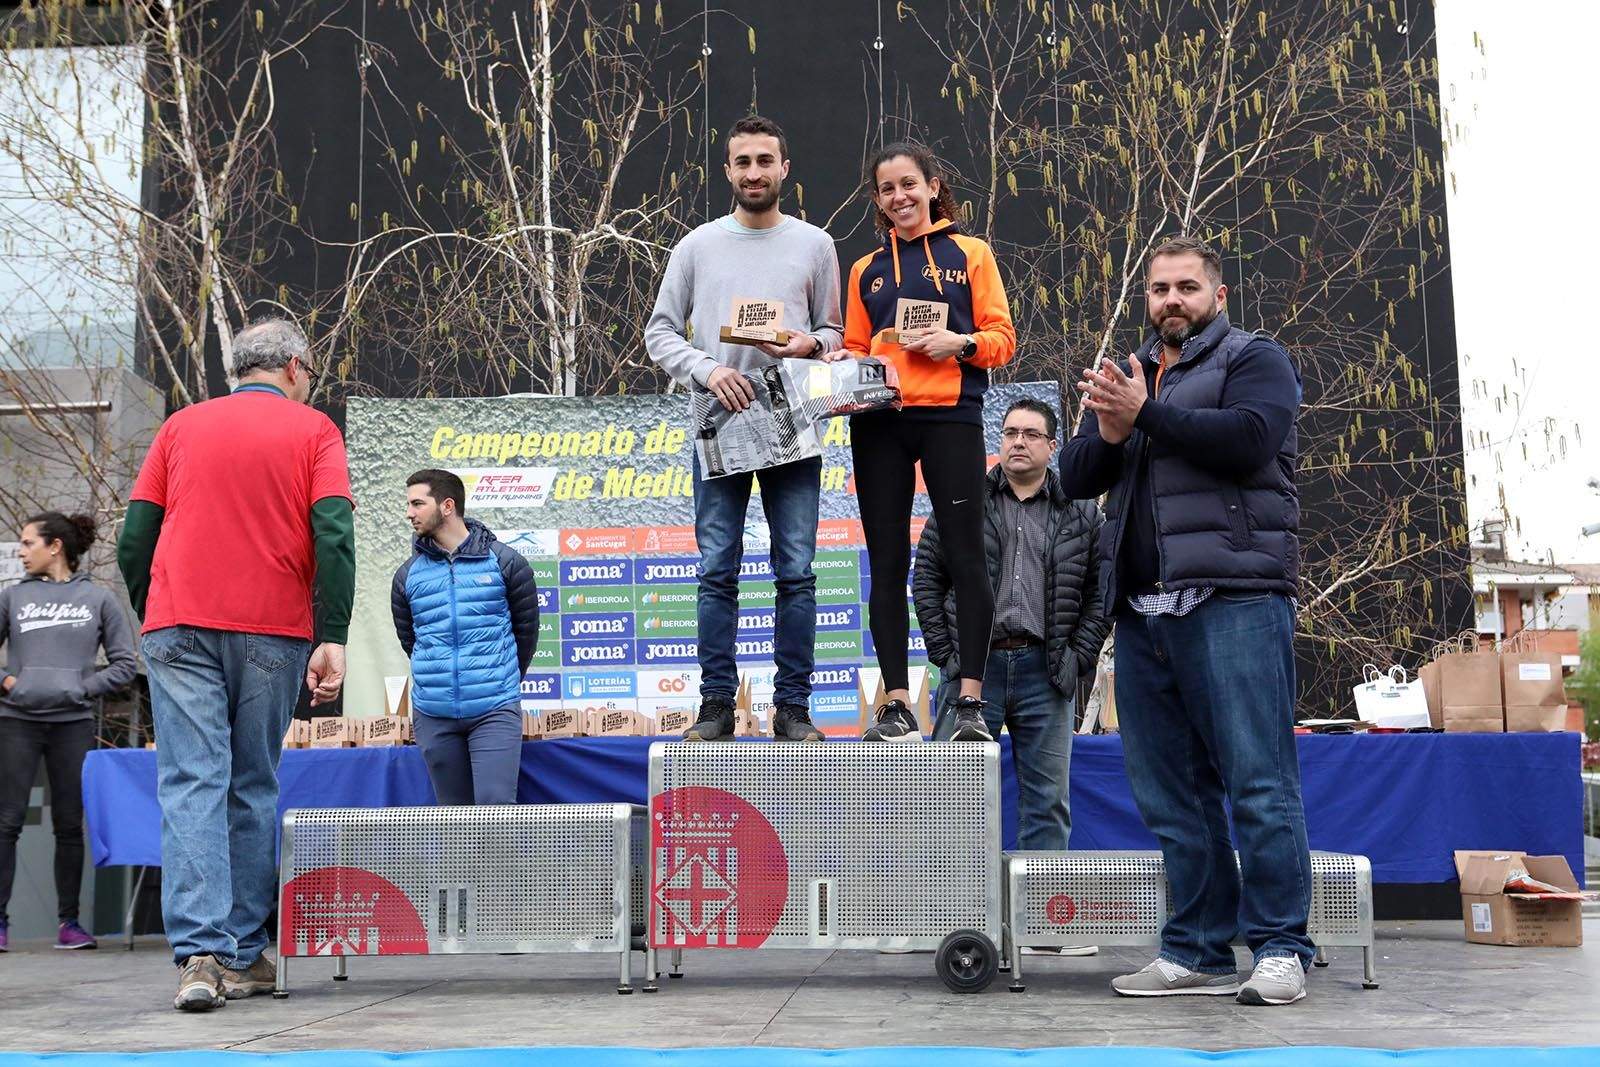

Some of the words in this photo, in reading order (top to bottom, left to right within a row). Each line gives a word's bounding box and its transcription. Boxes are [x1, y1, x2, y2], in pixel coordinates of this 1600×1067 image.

[430, 423, 635, 465] Campeonato
[644, 422, 686, 455] de
[475, 485, 541, 493] ATLETISMO
[554, 469, 595, 501] de
[501, 493, 543, 501] RUNNING
[816, 532, 848, 541] ntCugat
[586, 541, 626, 549] SantCugat
[811, 560, 853, 569] BERDROLA
[585, 595, 630, 604] IBERDROLA
[659, 594, 697, 602] IBERDROL
[17, 602, 93, 623] Sailfish
[661, 620, 697, 628] IBERDRO
[814, 641, 857, 650] BERDROLA
[588, 676, 631, 686] LOTERÍAS
[808, 669, 852, 684] oma
[814, 694, 858, 705] LOTERÍAS
